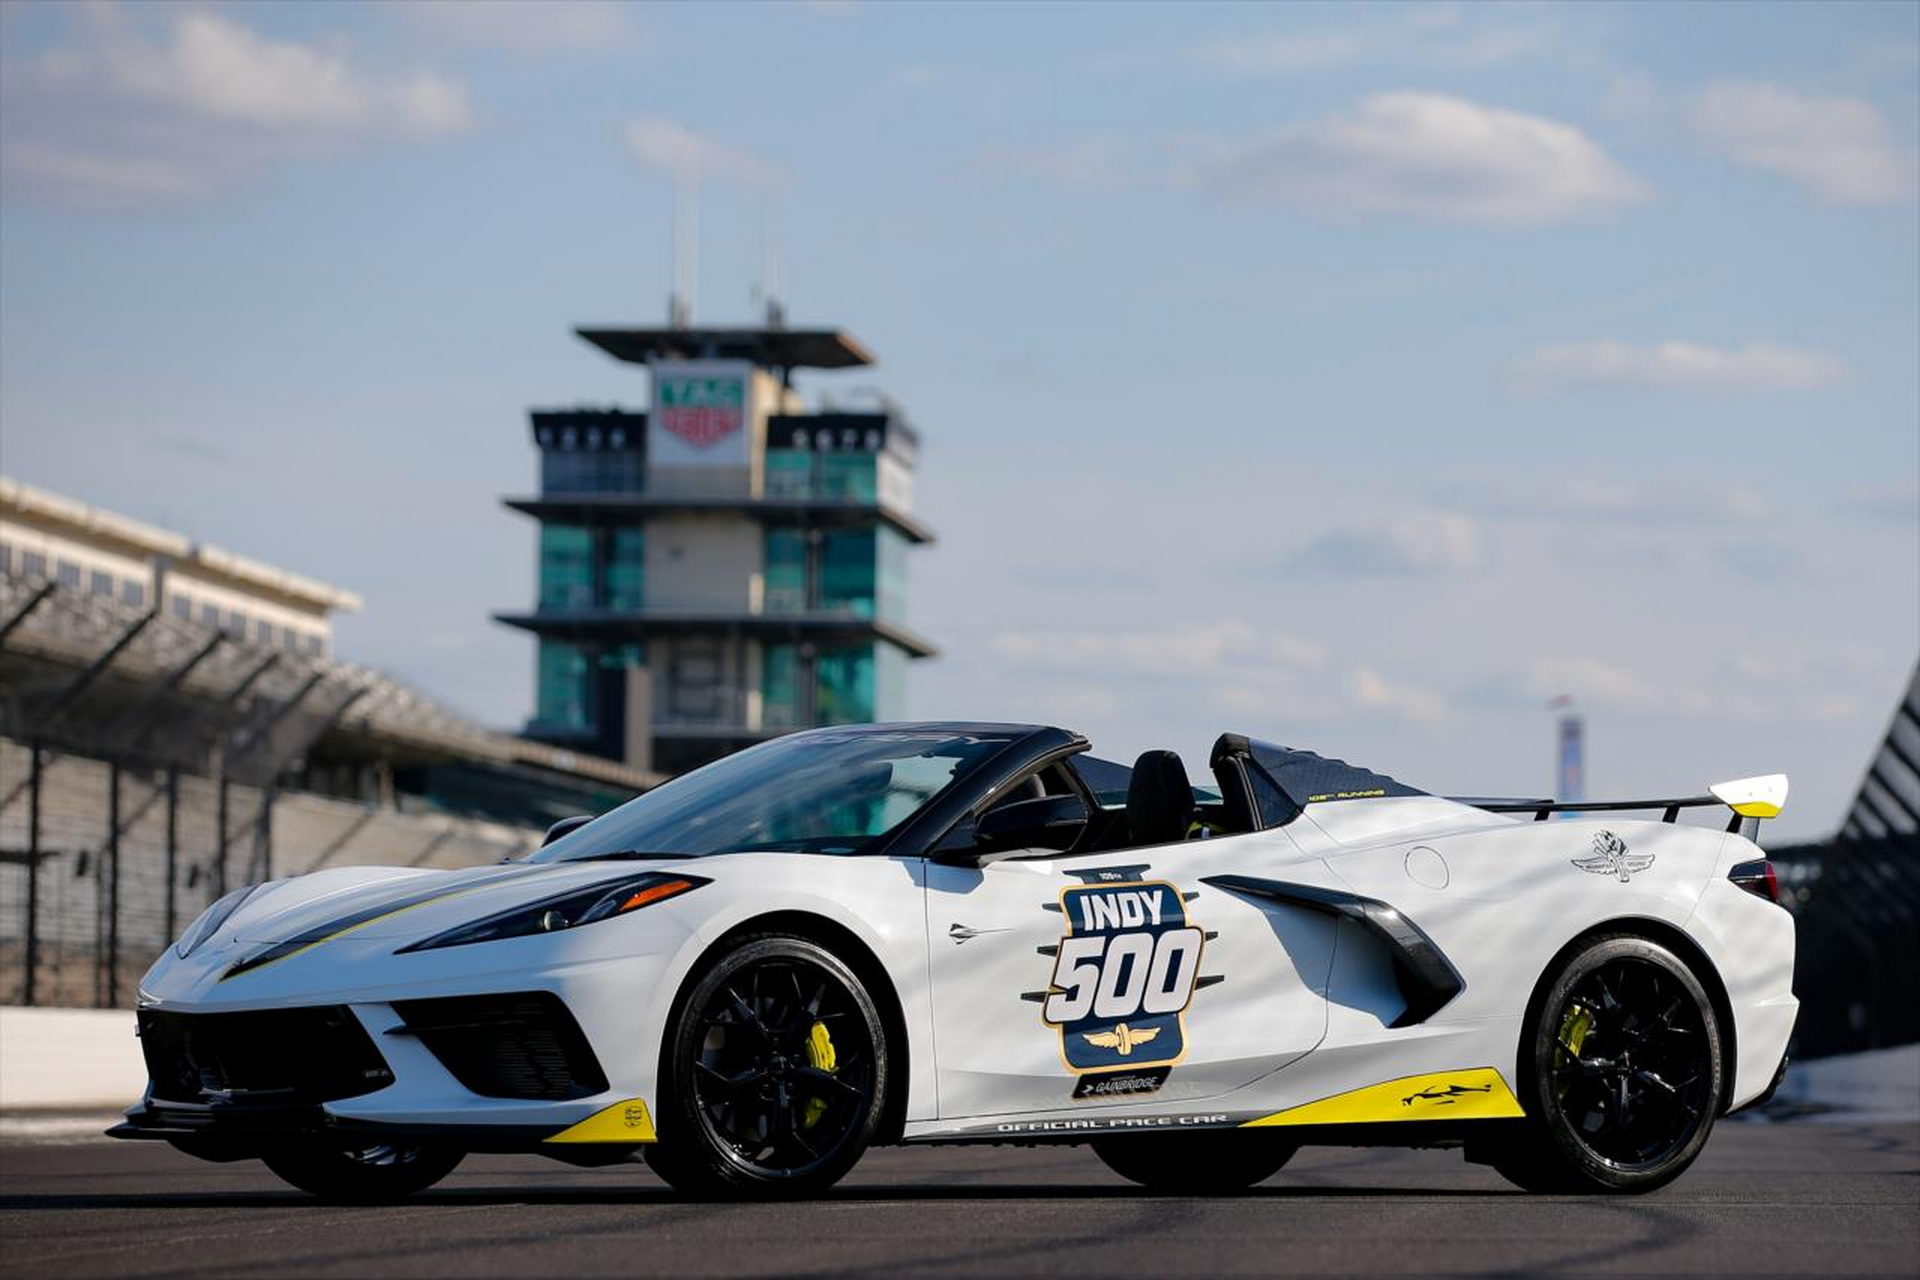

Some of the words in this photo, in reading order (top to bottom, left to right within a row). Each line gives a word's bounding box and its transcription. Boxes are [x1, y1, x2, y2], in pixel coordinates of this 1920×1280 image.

[1079, 889, 1163, 931] INDY
[1045, 928, 1203, 1022] 500
[1095, 1077, 1159, 1093] GAINBRIDGE
[998, 1121, 1103, 1132] OFFICIAL
[1109, 1117, 1172, 1128] PACE
[1180, 1114, 1228, 1125] CAR
